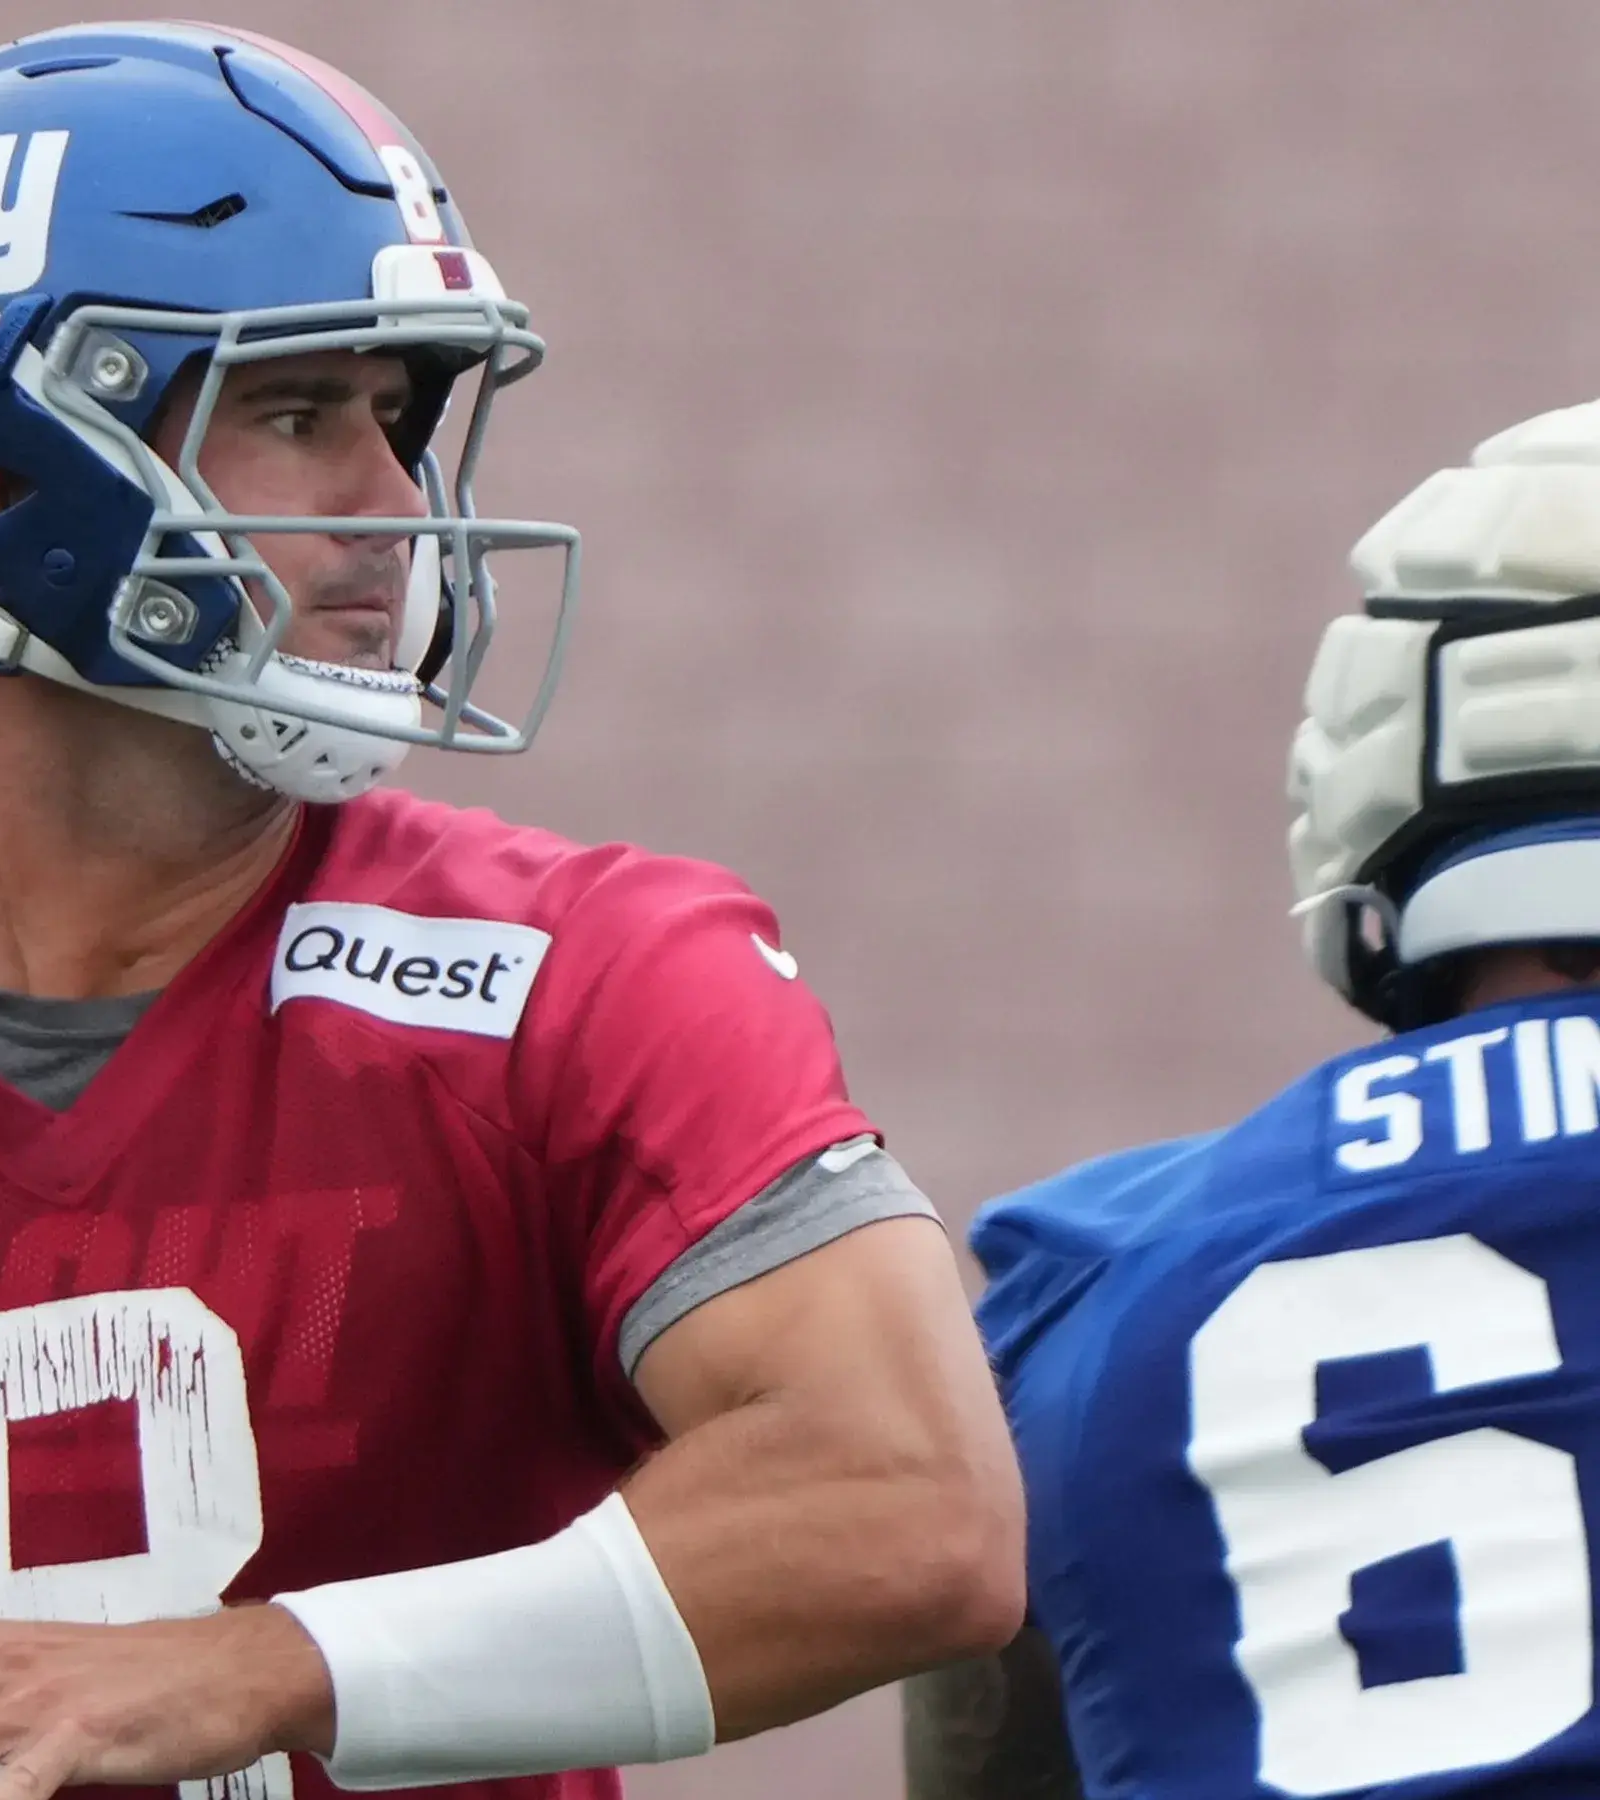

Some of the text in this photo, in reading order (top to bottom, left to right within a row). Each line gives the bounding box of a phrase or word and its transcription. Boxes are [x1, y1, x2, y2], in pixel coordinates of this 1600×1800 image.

[380, 145, 443, 240] 8
[285, 925, 511, 1003] Quest
[1186, 1232, 1594, 1798] 6
